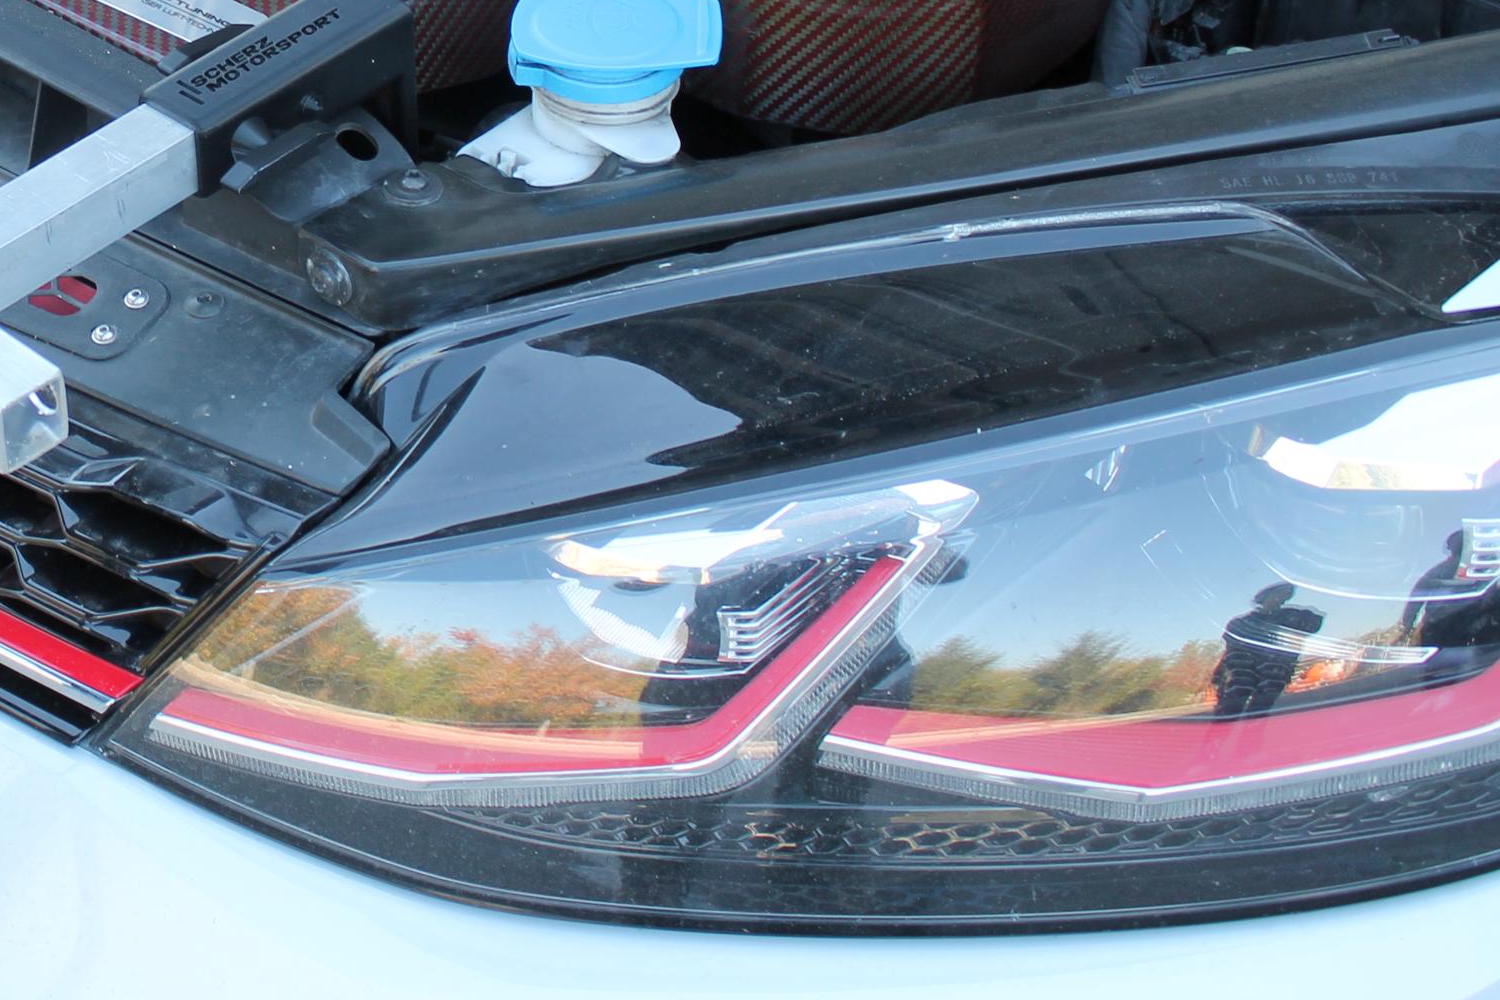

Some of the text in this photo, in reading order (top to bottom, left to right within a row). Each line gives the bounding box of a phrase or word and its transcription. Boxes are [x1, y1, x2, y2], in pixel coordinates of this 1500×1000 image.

[190, 35, 274, 88] SCHERZ
[205, 8, 341, 93] MOTORSPORT
[1219, 174, 1252, 190] SAE
